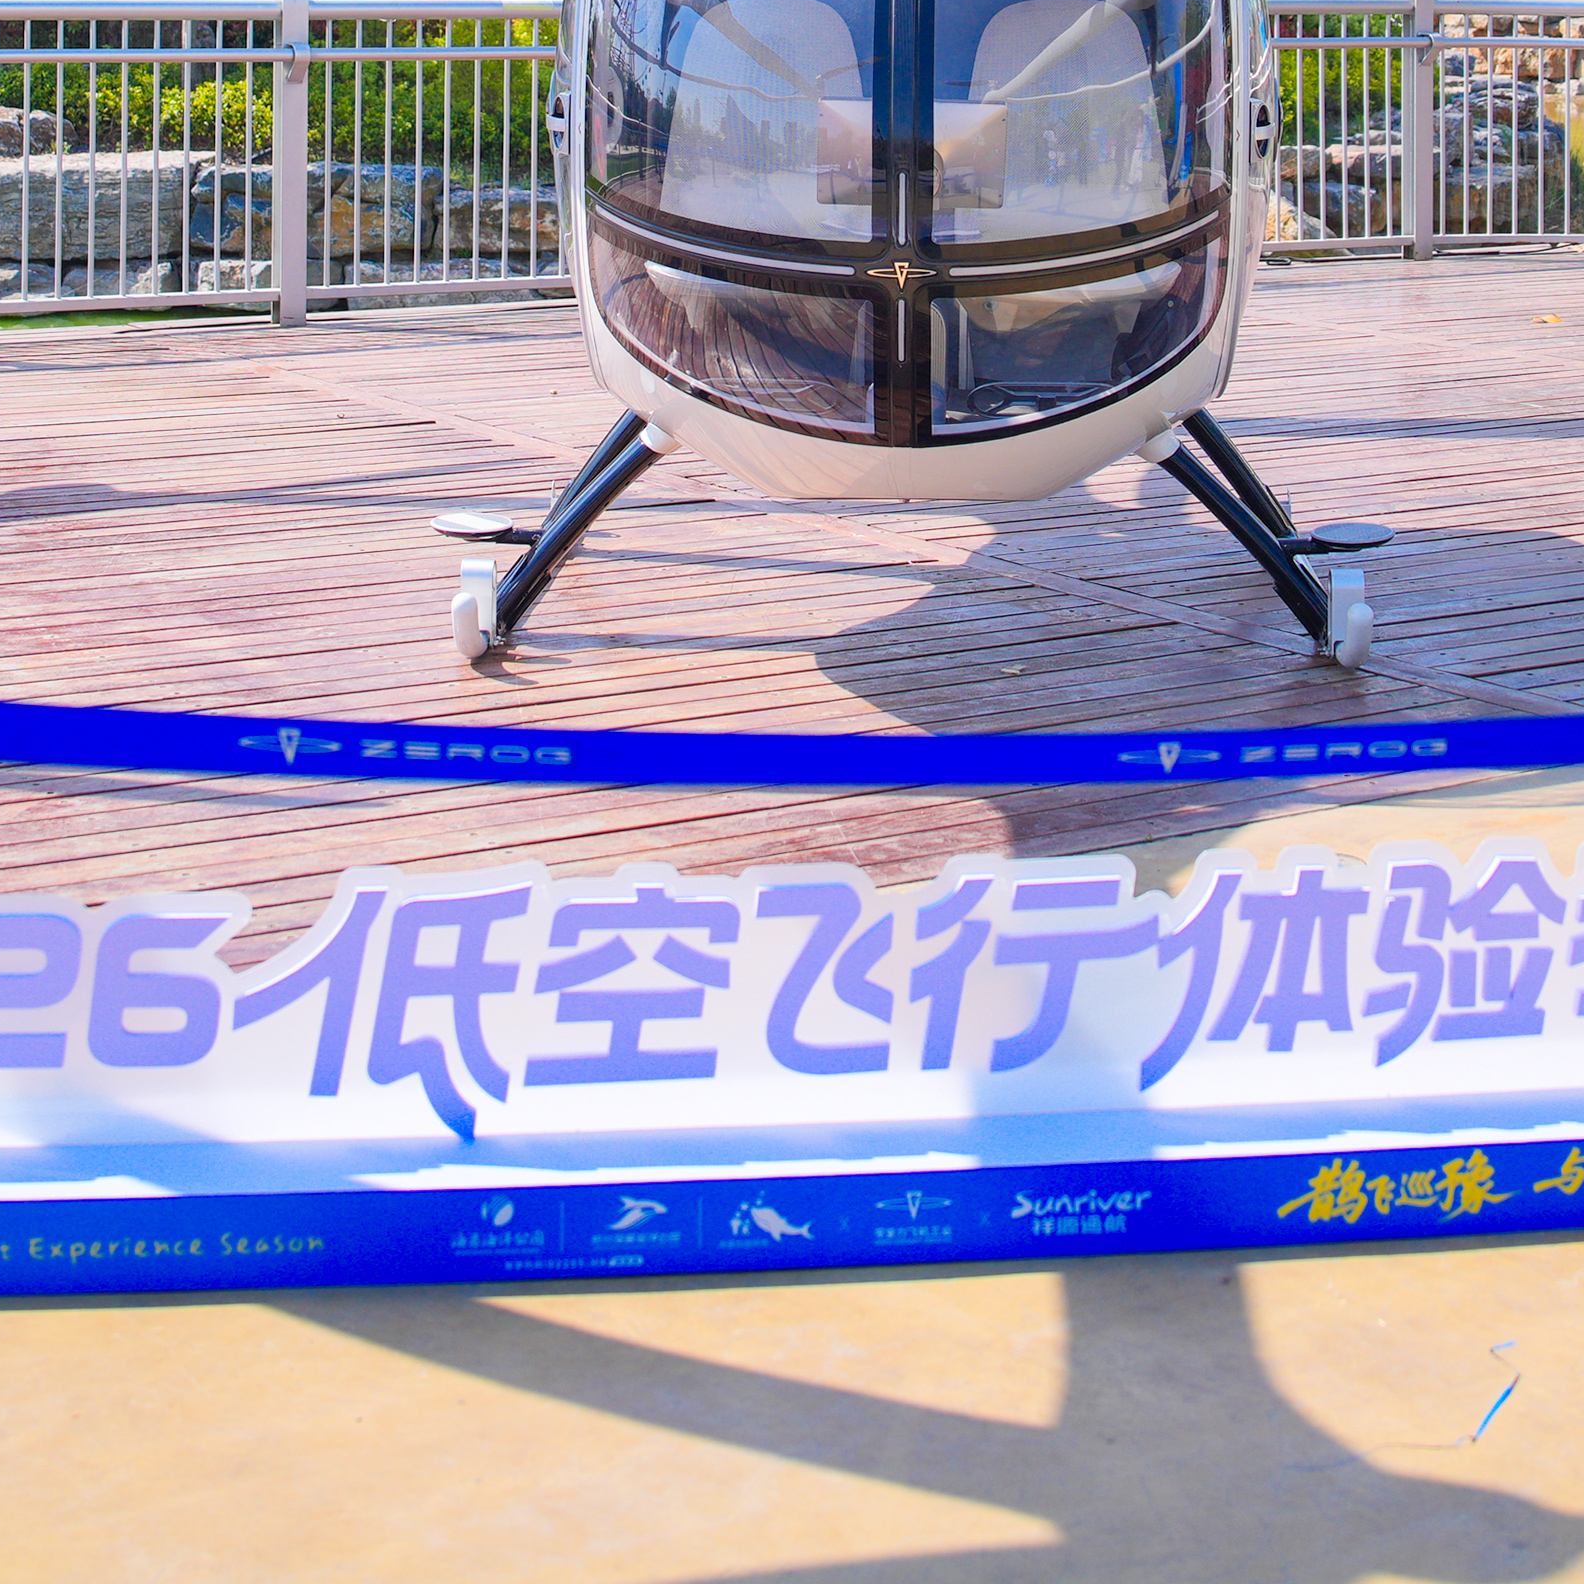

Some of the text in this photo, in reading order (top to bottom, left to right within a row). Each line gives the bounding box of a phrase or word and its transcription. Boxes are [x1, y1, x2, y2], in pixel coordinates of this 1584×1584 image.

[359, 738, 572, 765] ZEROG
[1238, 737, 1449, 763] ZEROG
[1011, 1189, 1152, 1218] Sunriver
[28, 1236, 204, 1265] Experience
[219, 1231, 324, 1256] Season
